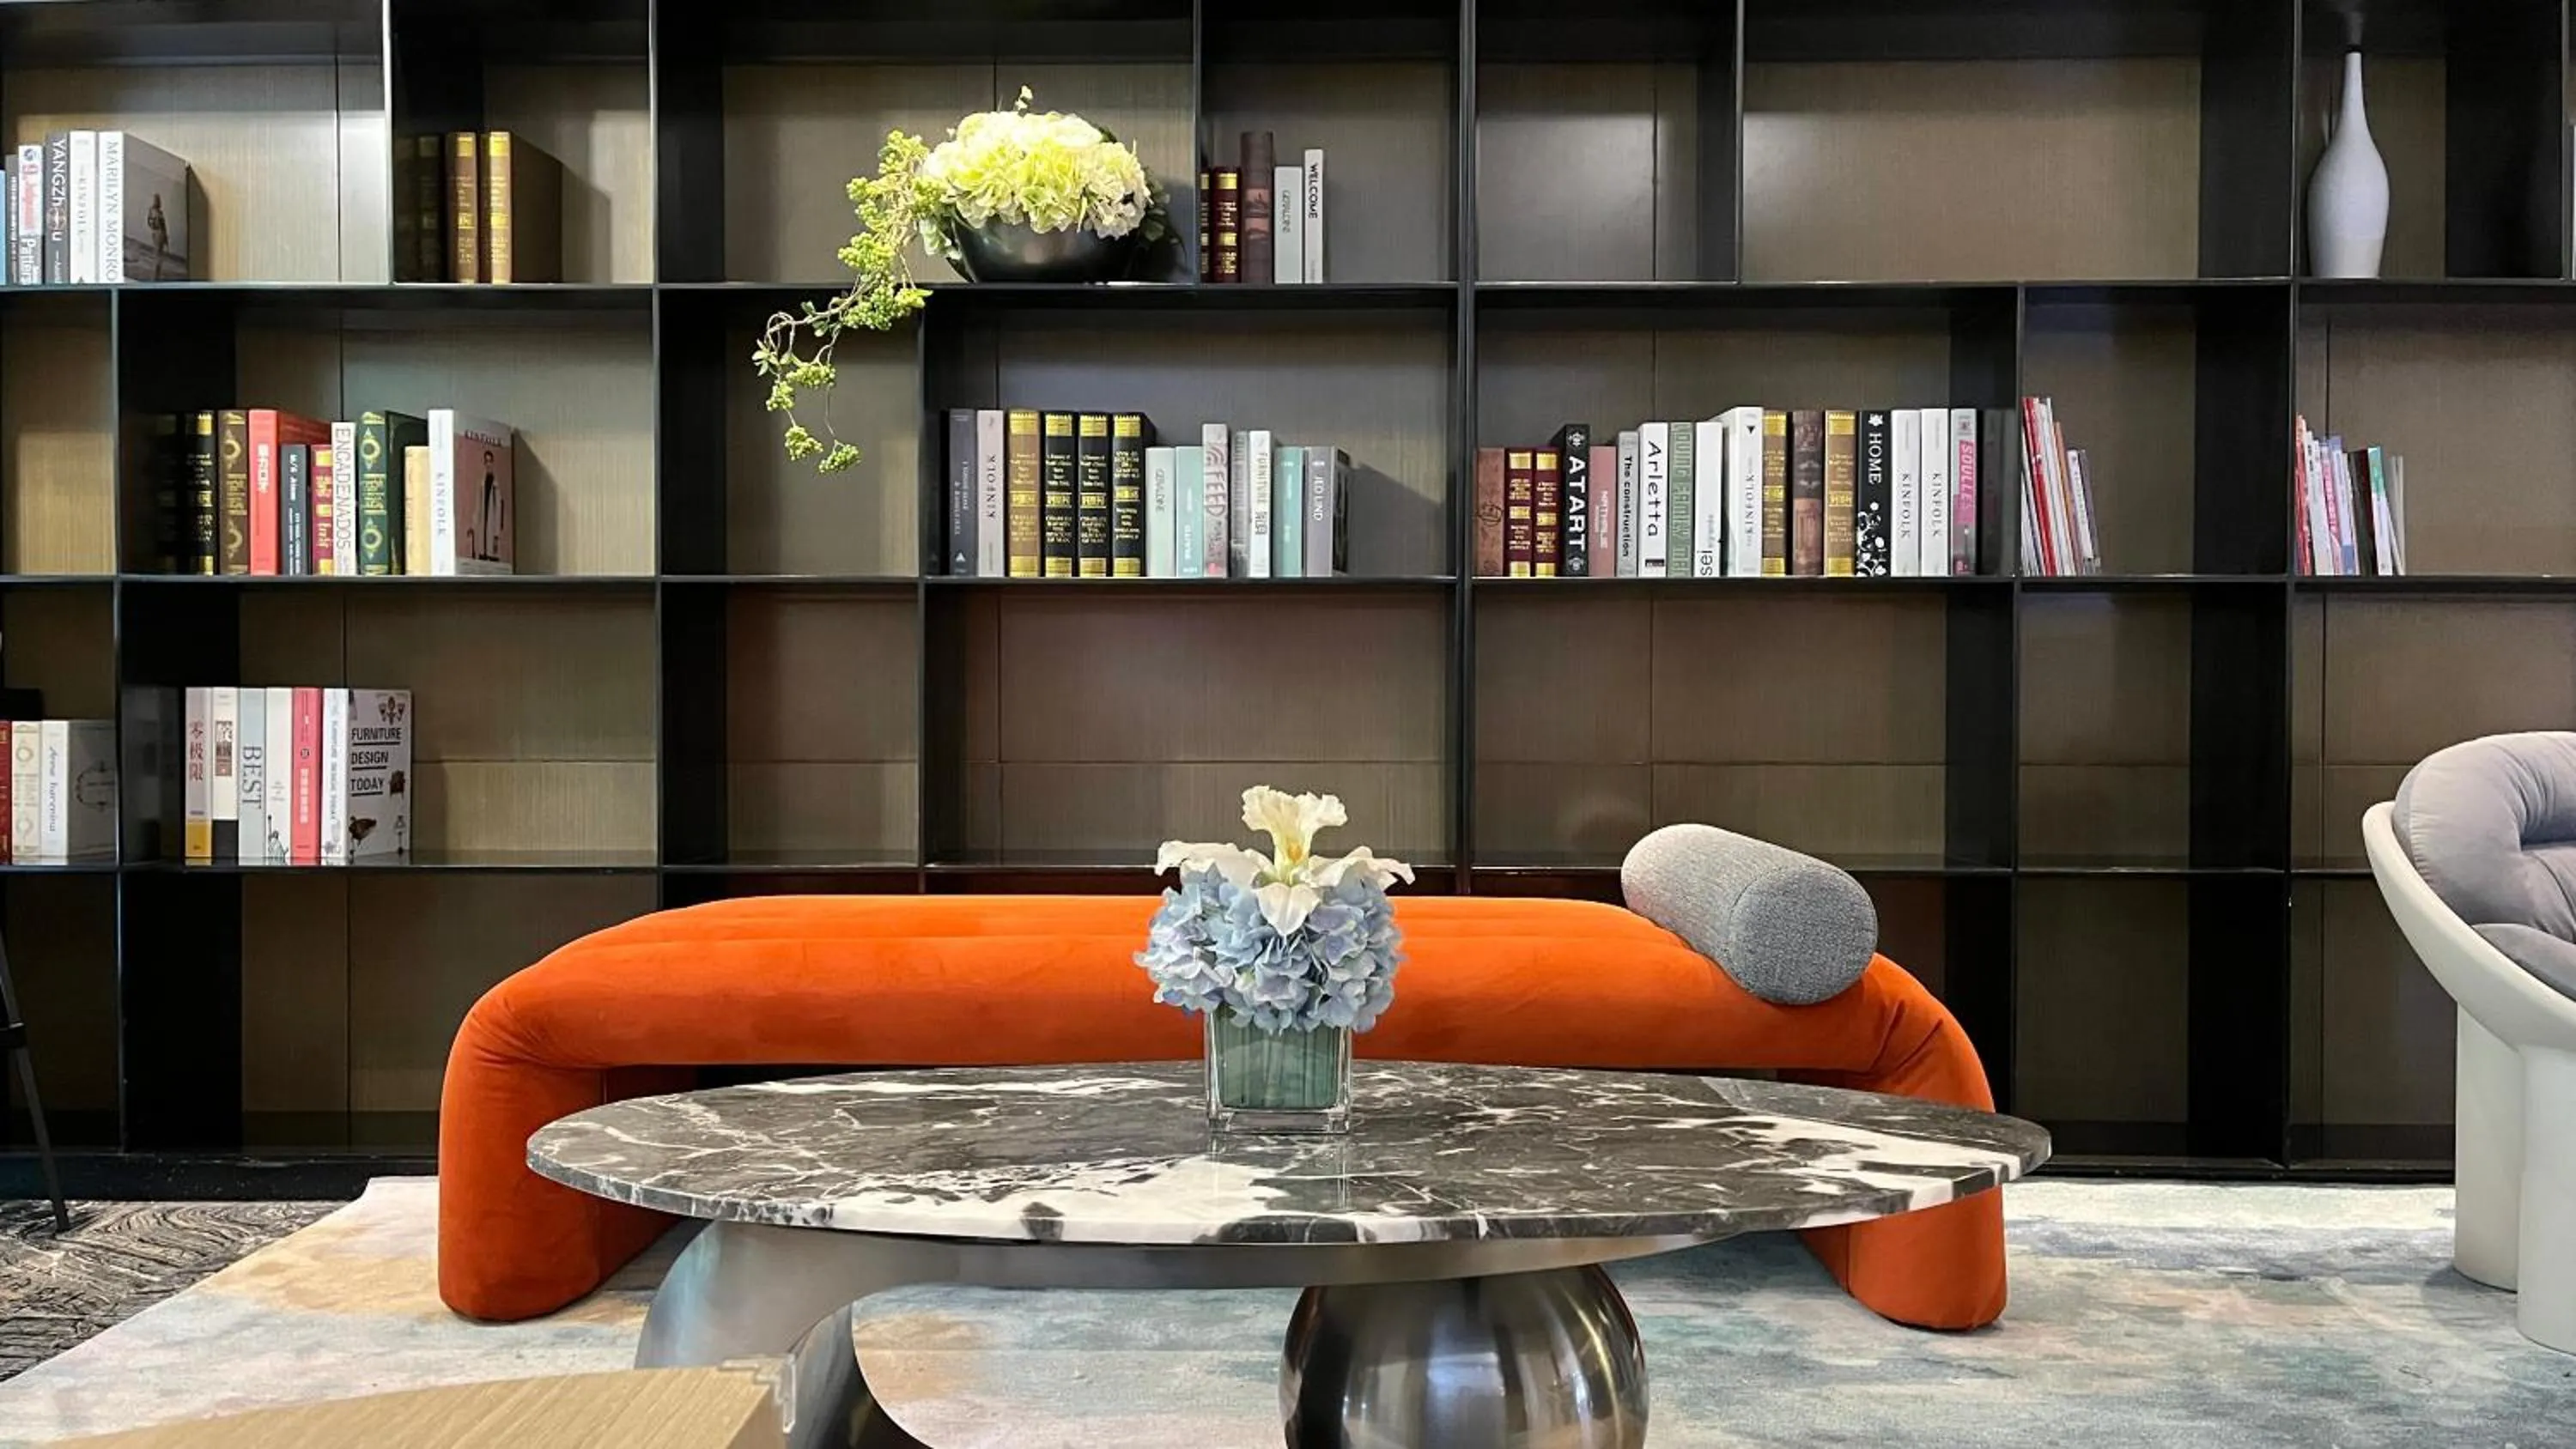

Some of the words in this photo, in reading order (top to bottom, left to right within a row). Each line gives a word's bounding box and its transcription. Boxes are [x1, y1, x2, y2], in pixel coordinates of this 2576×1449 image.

[106, 141, 119, 214] MARILYN
[1308, 162, 1319, 219] WELCOME
[987, 454, 996, 520] KINFOLK
[1623, 456, 1633, 477] The
[1647, 440, 1663, 537] Arletta
[1868, 432, 1882, 485] HOME
[436, 471, 447, 537] KINFOLK
[1206, 470, 1226, 517] FEED
[1622, 481, 1632, 557] construction
[1744, 474, 1755, 536] KINFOLK
[1901, 473, 1911, 539] KINFOLK
[1932, 472, 1942, 537] KINFOLK
[351, 727, 402, 741] FURNITURE
[351, 751, 389, 765] DESIGN
[242, 745, 263, 810] BEST
[350, 777, 385, 791] TODAY
